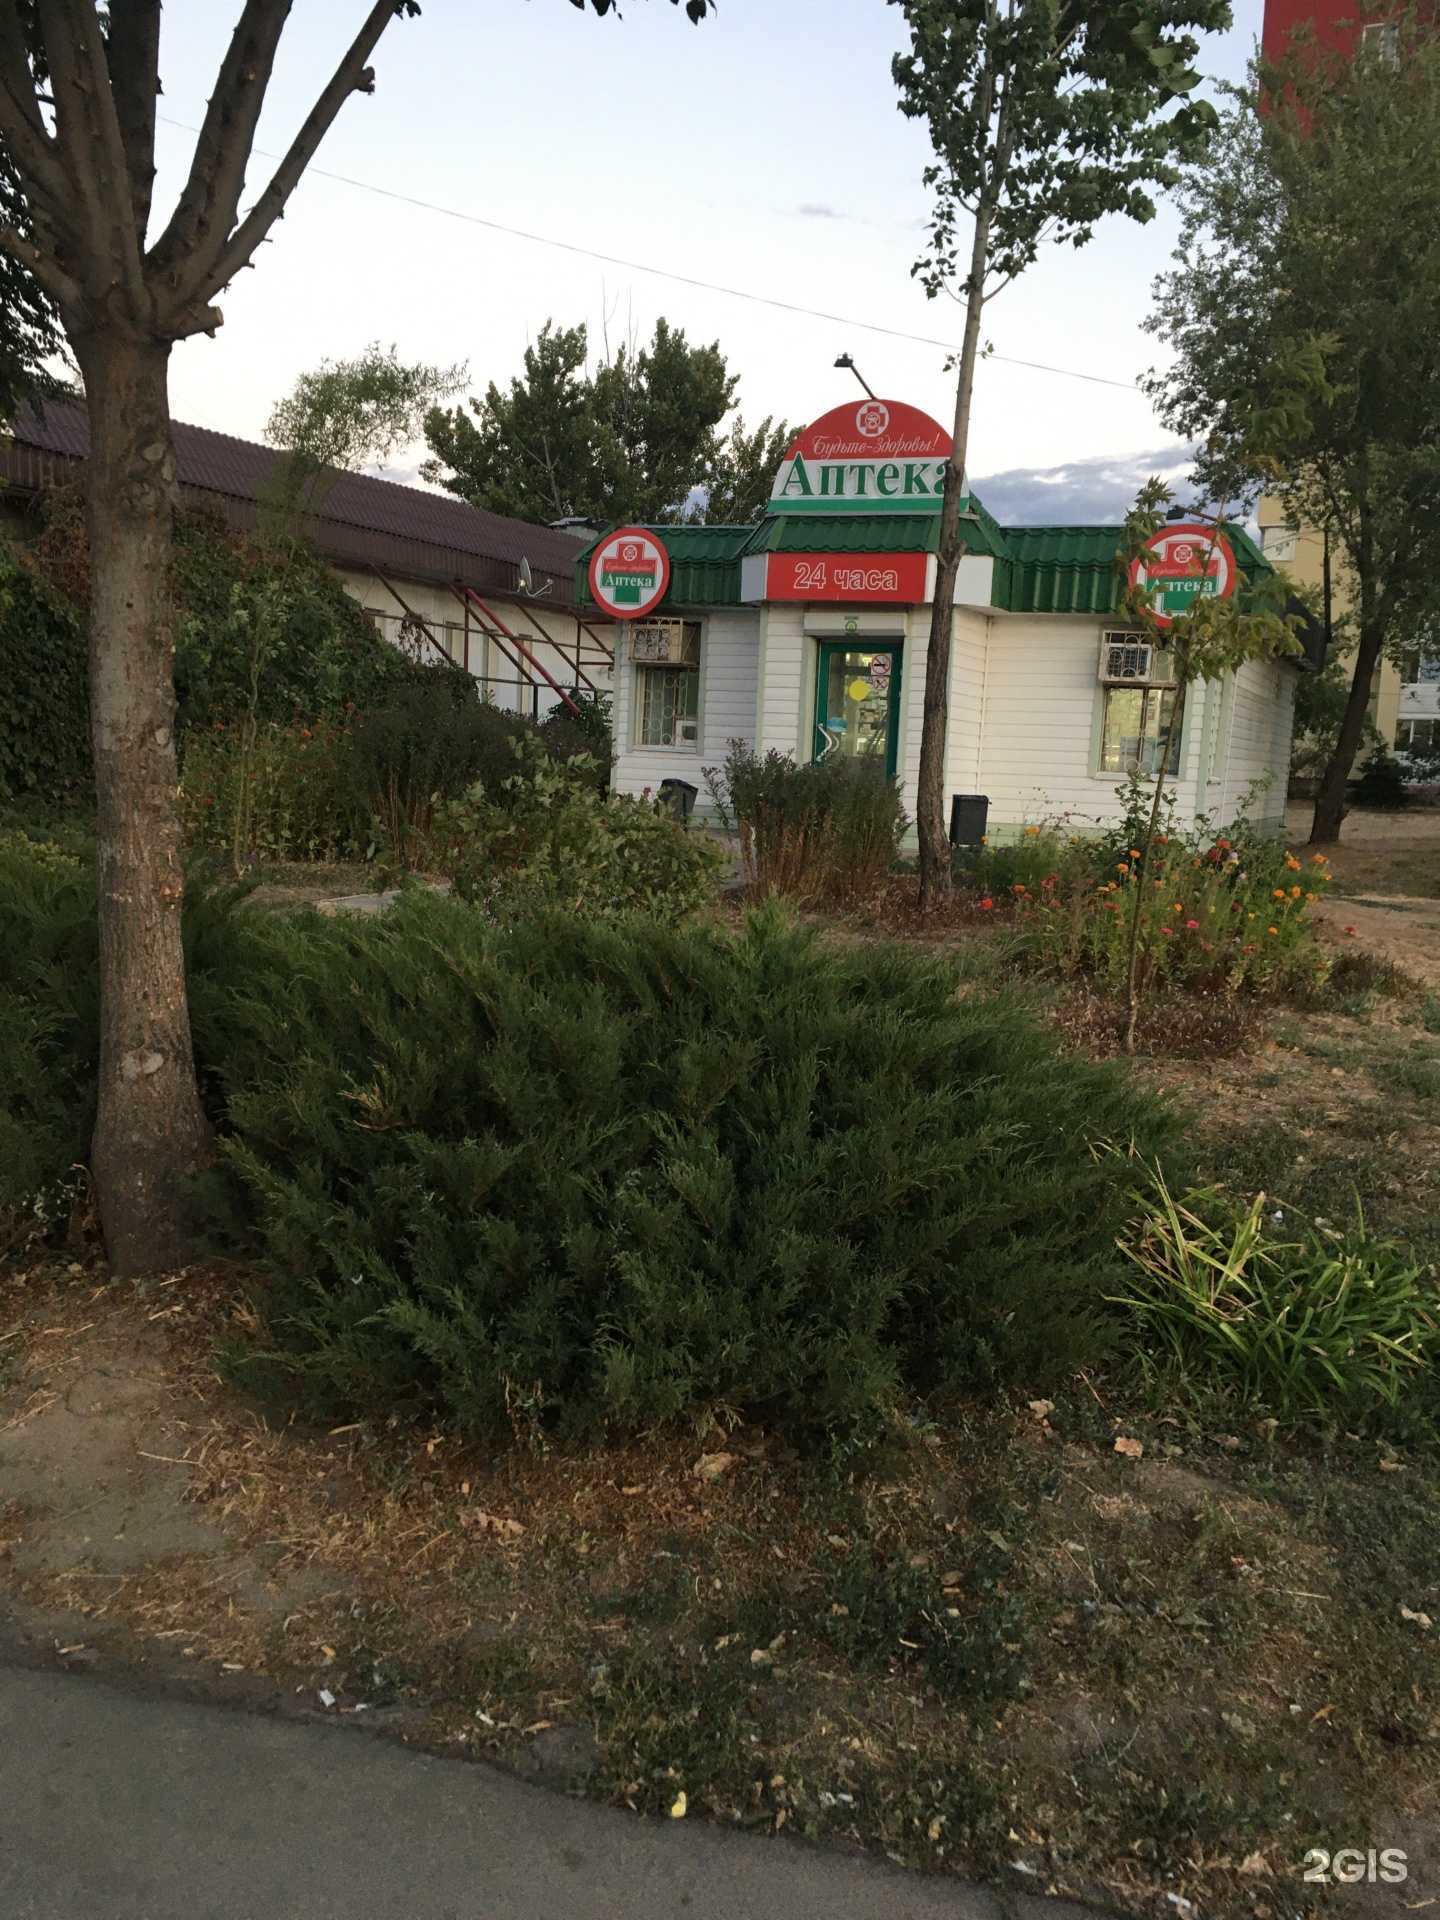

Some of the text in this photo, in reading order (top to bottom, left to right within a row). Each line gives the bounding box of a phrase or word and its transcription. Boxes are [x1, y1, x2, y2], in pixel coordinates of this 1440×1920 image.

[605, 573, 652, 587] Аптека
[794, 562, 898, 591] 24 часа
